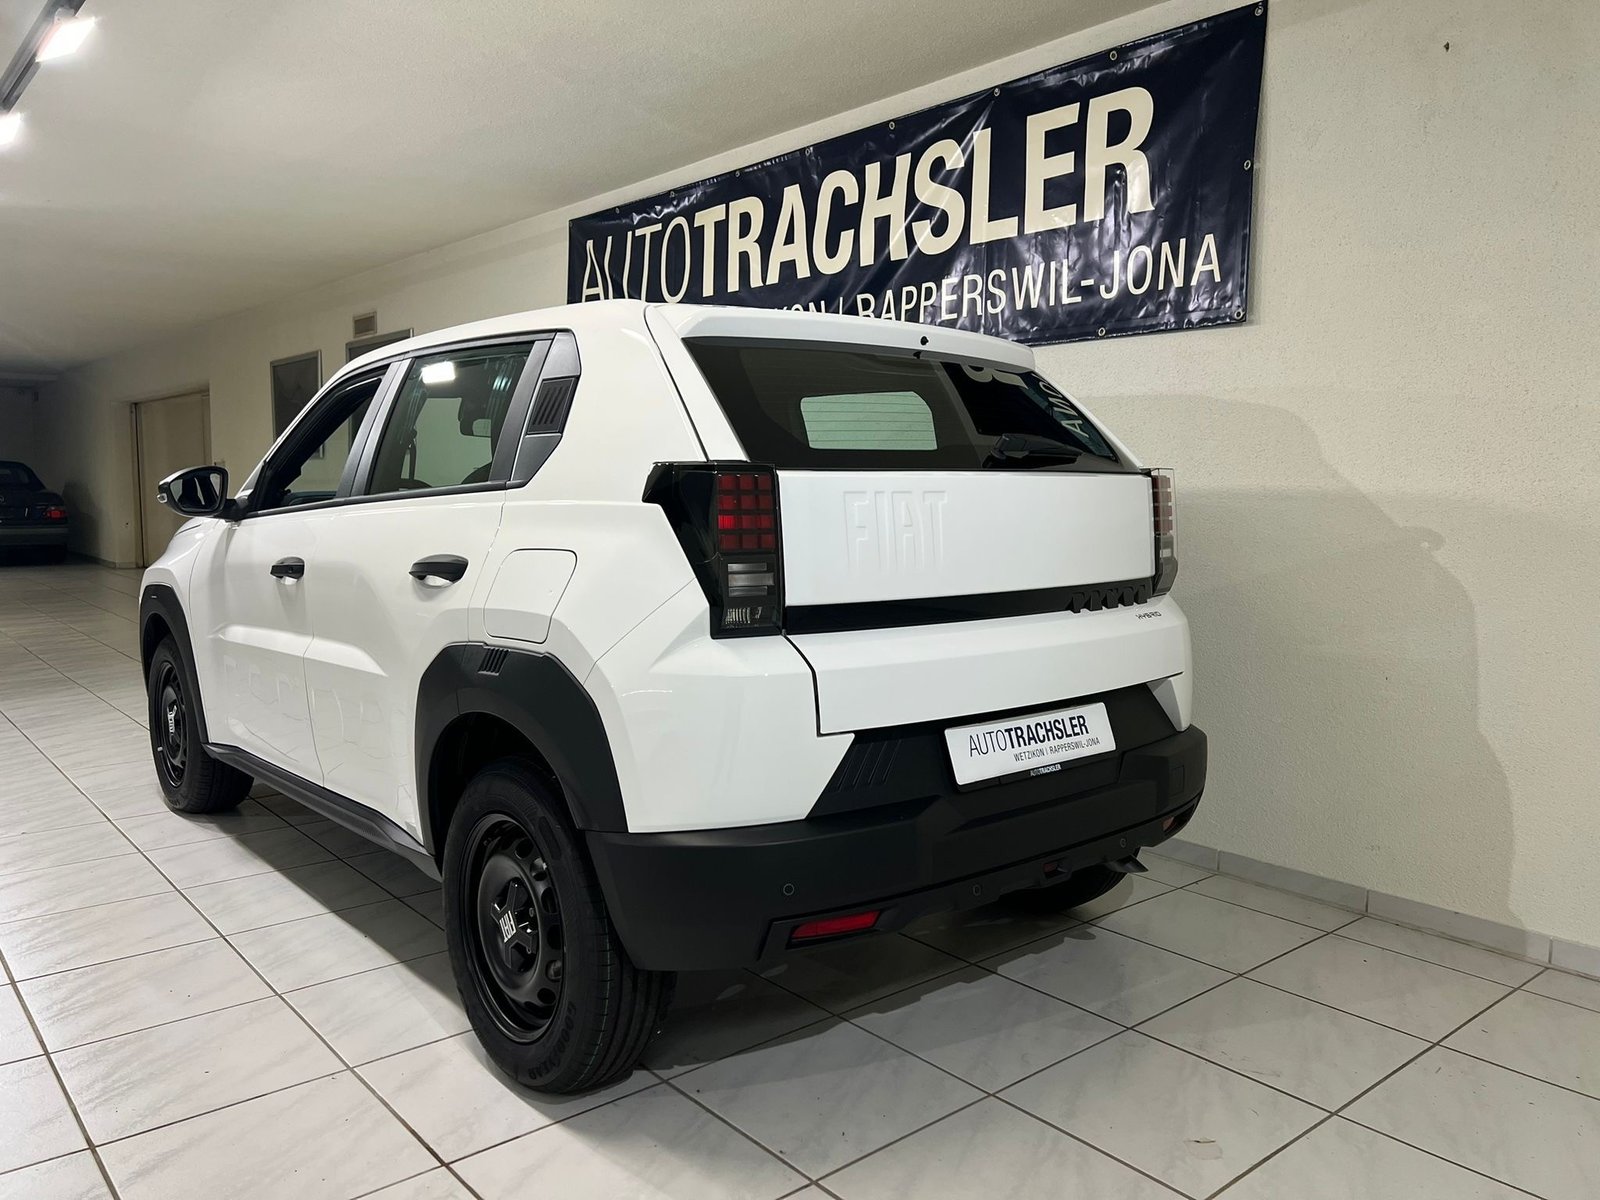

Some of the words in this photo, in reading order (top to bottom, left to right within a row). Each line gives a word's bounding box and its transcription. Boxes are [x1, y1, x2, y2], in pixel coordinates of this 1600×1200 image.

[581, 86, 1154, 304] AUTOTRACHSLER
[856, 232, 1222, 322] RAPPERSWIL-JONA
[843, 489, 949, 574] FIAT
[968, 715, 1089, 757] AUTOTRACHSLER
[1013, 749, 1045, 762] WETZIKON
[1050, 737, 1101, 754] RAPPERSWIL-JONA
